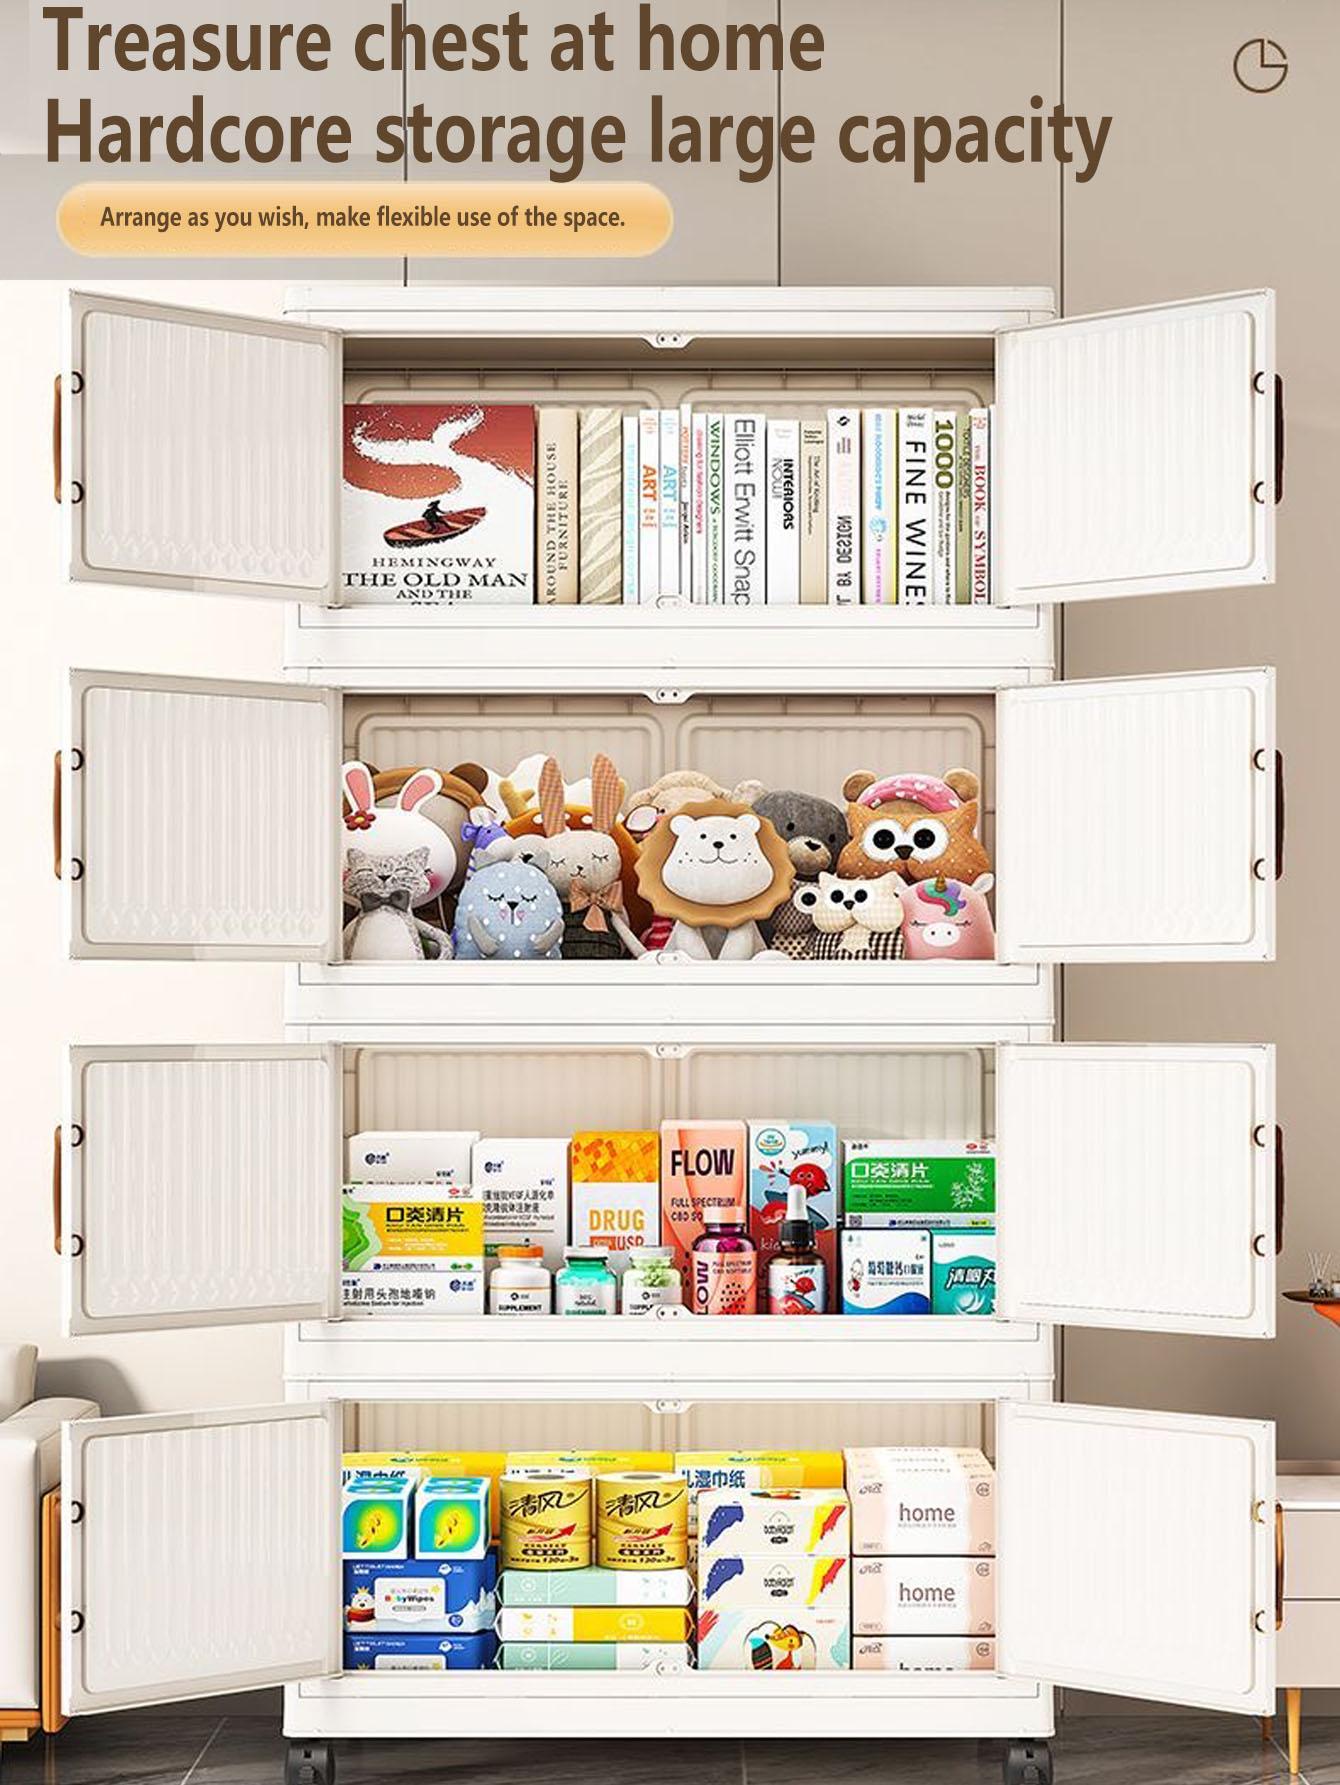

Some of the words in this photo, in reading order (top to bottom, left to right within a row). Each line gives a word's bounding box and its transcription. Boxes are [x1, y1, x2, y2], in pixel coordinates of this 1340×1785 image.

[735, 419, 756, 475] Elliott
[935, 420, 954, 489] 1000
[546, 443, 556, 496] HOUSE
[643, 464, 656, 501] ART
[663, 464, 677, 502] ART
[710, 420, 720, 515] WINDOWS
[772, 458, 782, 499] NOW!
[906, 441, 926, 504] FINE
[783, 458, 795, 530] INTERIORS
[974, 465, 985, 512] BOOK
[546, 502, 556, 534] THE
[558, 480, 568, 570] FURNITURE
[735, 483, 756, 542] Erwitt
[373, 557, 496, 568] HEMINGWAY
[732, 549, 756, 606] Snap
[343, 572, 397, 587] THE
[404, 572, 461, 587] OLD
[469, 573, 527, 587] MAN
[396, 588, 430, 599] AND
[436, 588, 472, 599] THE
[670, 1148, 735, 1177] FLOW
[851, 1162, 929, 1179] 口炎清片
[386, 1206, 464, 1223] 口炎清片
[670, 1197, 690, 1208] FULL
[692, 1197, 736, 1208] SPECTRUM
[670, 1211, 690, 1222] CBD
[589, 1209, 645, 1231] DRUG
[616, 1235, 645, 1251] USP
[498, 1304, 542, 1312] SUPPLEMENT
[898, 1502, 956, 1522] home
[898, 1582, 956, 1602] home
